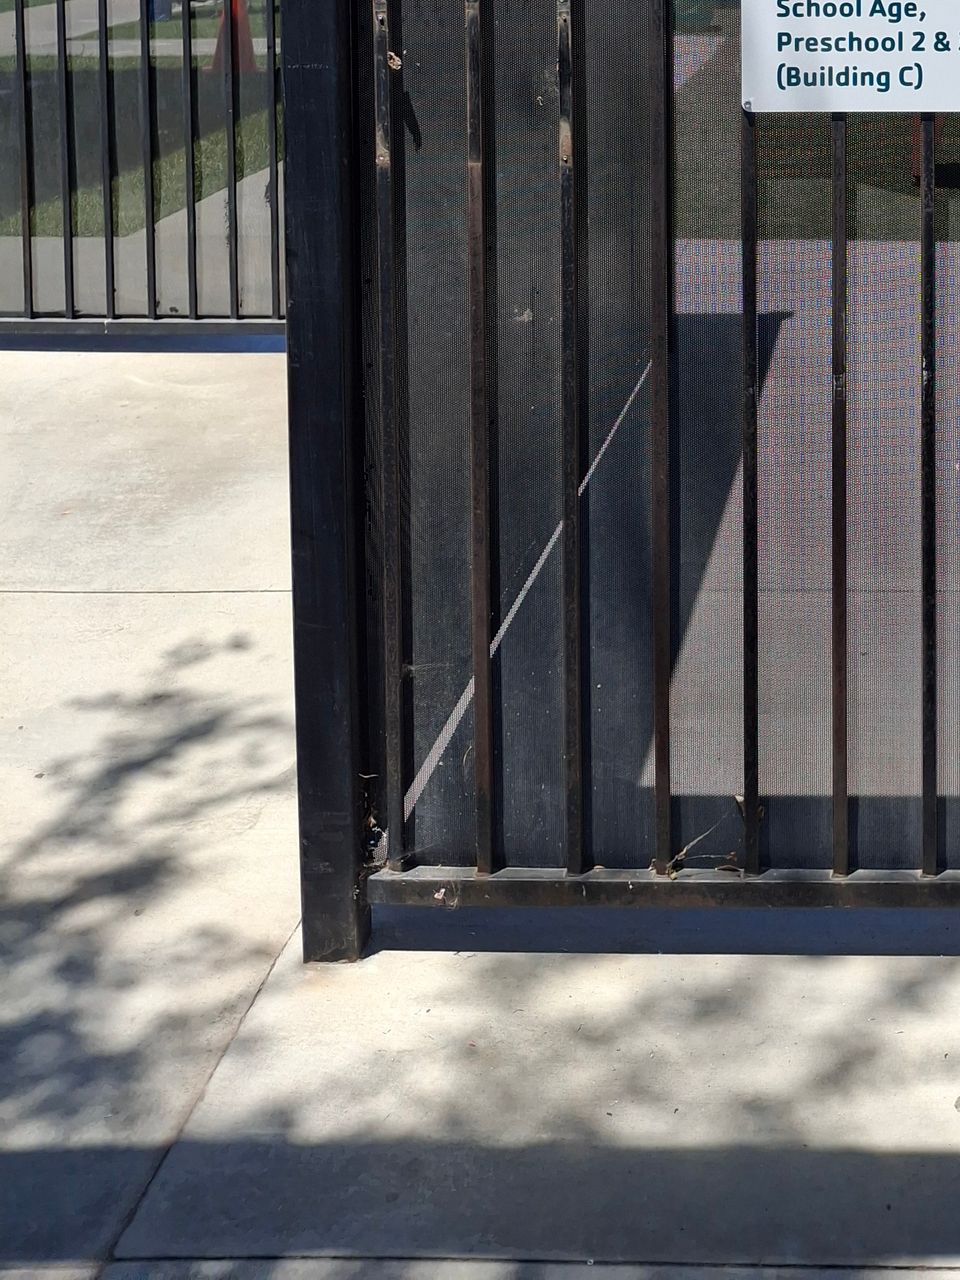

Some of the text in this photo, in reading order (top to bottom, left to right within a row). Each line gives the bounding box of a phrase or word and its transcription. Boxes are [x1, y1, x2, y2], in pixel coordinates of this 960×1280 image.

[778, 31, 903, 52] Preschool
[912, 32, 925, 51] 2
[934, 32, 951, 52] &
[777, 63, 922, 92] (Building C)
